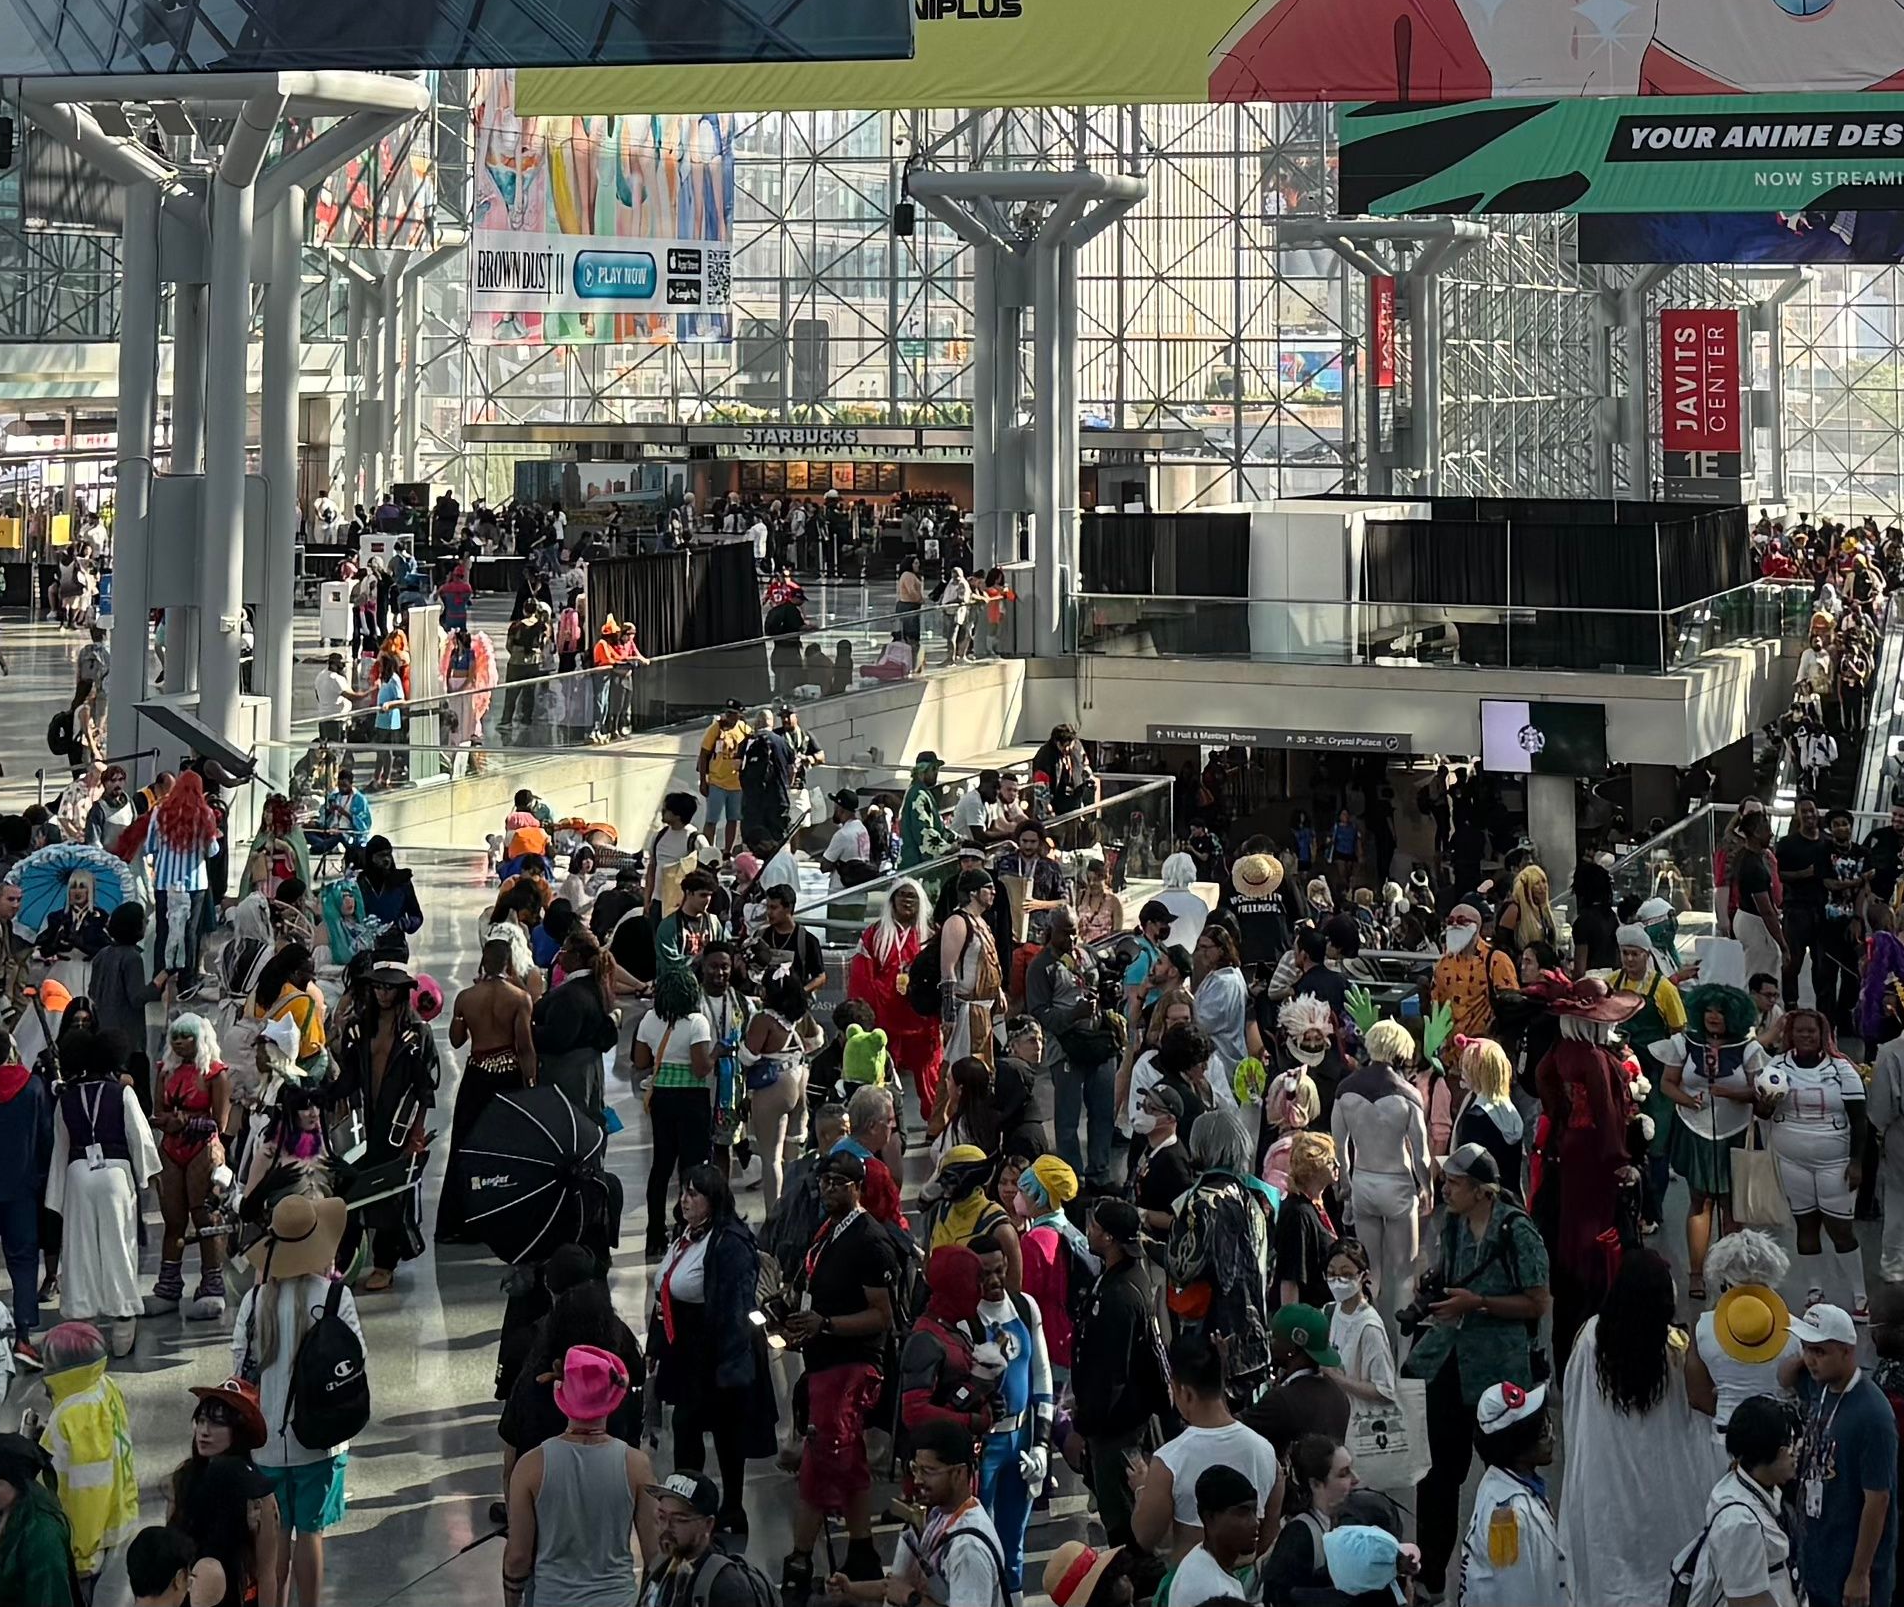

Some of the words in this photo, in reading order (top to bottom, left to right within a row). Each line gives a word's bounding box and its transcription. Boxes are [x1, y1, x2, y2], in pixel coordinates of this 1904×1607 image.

[1630, 126, 1714, 149] YOUR
[1721, 124, 1834, 148] ANIME
[1754, 171, 1802, 187] NOW
[477, 250, 521, 288] BROWN
[522, 248, 554, 300] DUST
[598, 267, 622, 285] PLAY
[1674, 327, 1697, 431] JAVITS
[1708, 327, 1726, 432] CENTER
[743, 429, 857, 443] STARBUCKS
[1685, 452, 1719, 478] 1E
